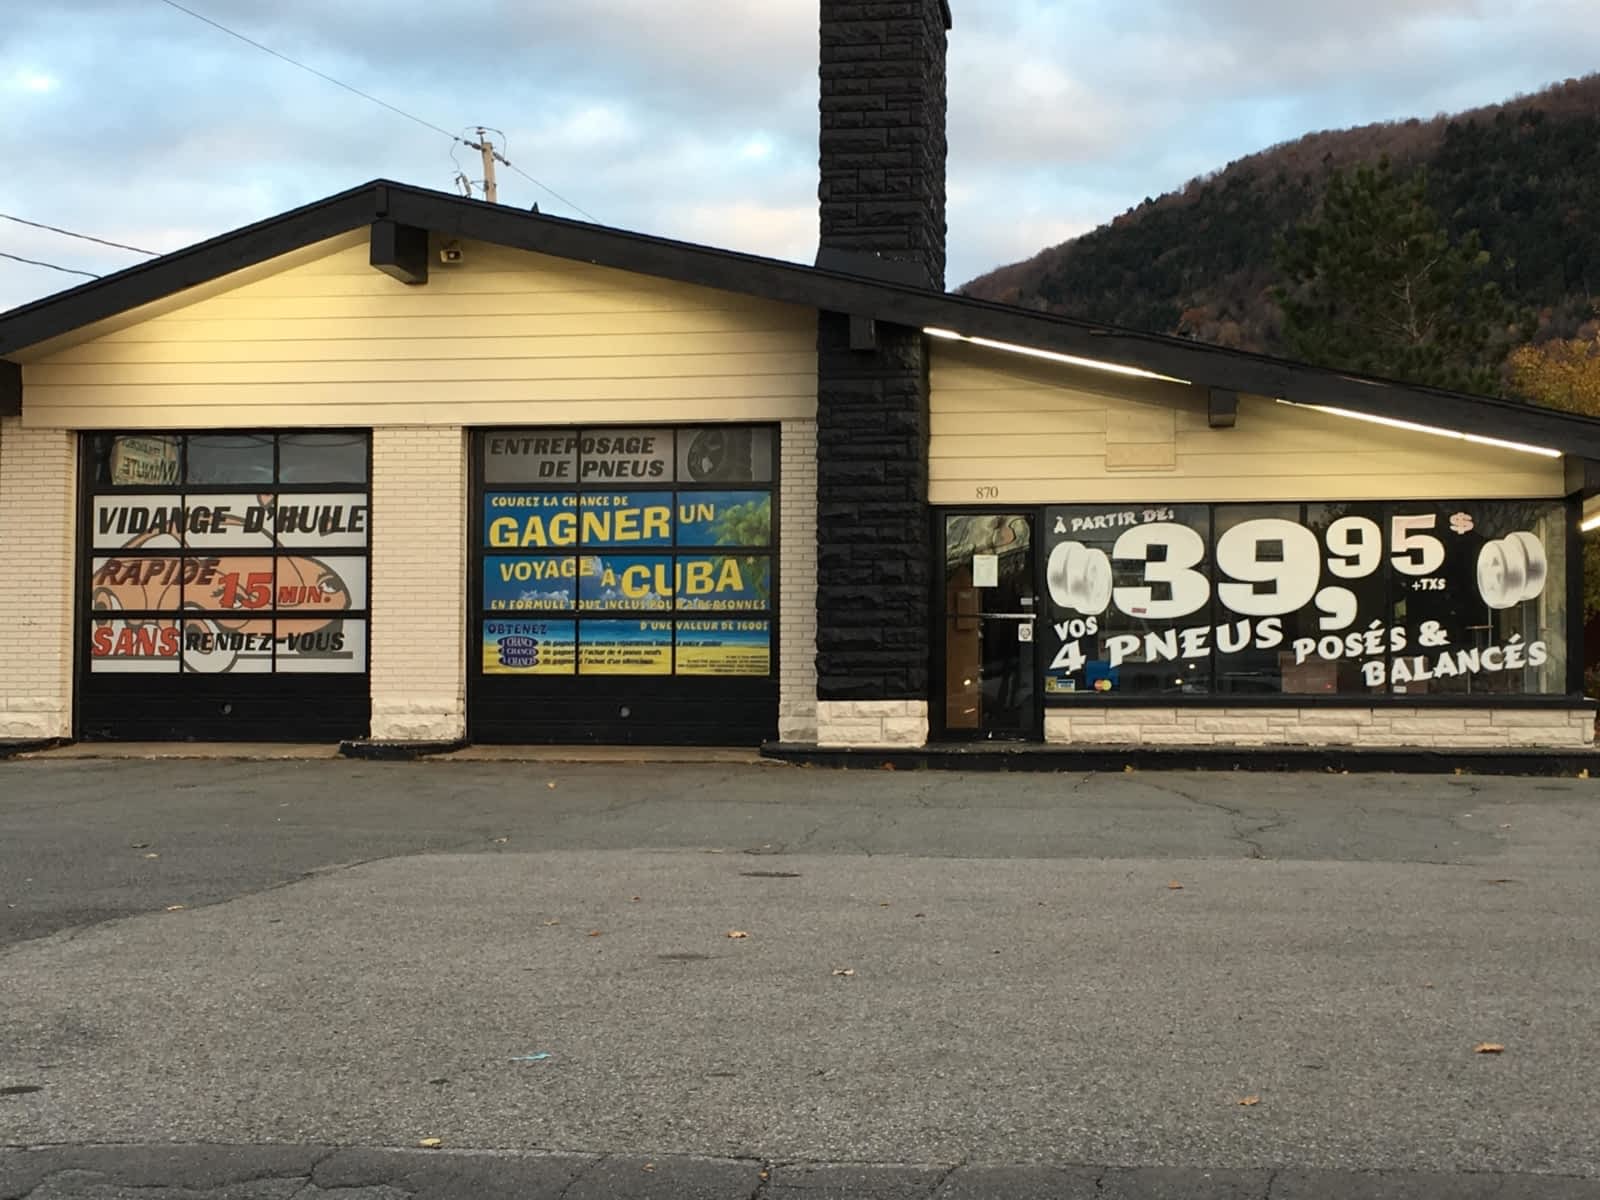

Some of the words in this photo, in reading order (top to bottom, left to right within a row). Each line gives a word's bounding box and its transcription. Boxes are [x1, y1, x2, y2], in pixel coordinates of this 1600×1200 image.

[491, 436, 656, 456] ENTREPOSAGE
[539, 460, 571, 478] DE
[582, 459, 665, 478] PNEUS
[492, 496, 540, 507] COUREZ
[543, 496, 559, 506] LA
[562, 496, 609, 507] CHANCE
[613, 496, 629, 506] DE
[975, 486, 999, 499] 870
[99, 505, 231, 534] VIDANGE
[242, 505, 367, 533] D'HUILE
[489, 506, 671, 547] GAGNER
[679, 504, 715, 524] UN
[1071, 511, 1138, 532] PARTIR
[97, 559, 221, 586] RAPIDE
[500, 557, 594, 582] VOYAGE
[620, 558, 744, 600] CUBA
[1411, 578, 1446, 590] +TXS
[218, 572, 273, 609] 15
[278, 585, 332, 604] MIN.
[491, 600, 506, 609] EN
[509, 600, 565, 609] FORMULE
[570, 600, 601, 609] TOUT
[605, 600, 645, 609] INCLUS
[487, 624, 547, 635] OBTENEZ
[676, 621, 718, 631] VALEUR
[721, 621, 734, 630] DE
[1053, 616, 1098, 641] VOS
[92, 627, 180, 656] SANS
[185, 632, 345, 651] RENDEZ-VOUS
[1050, 640, 1086, 672] 4
[1105, 617, 1283, 668] PNEUS
[1293, 619, 1407, 665] POSÉS
[1418, 620, 1450, 647] &
[1361, 633, 1547, 686] BALANCÉS
